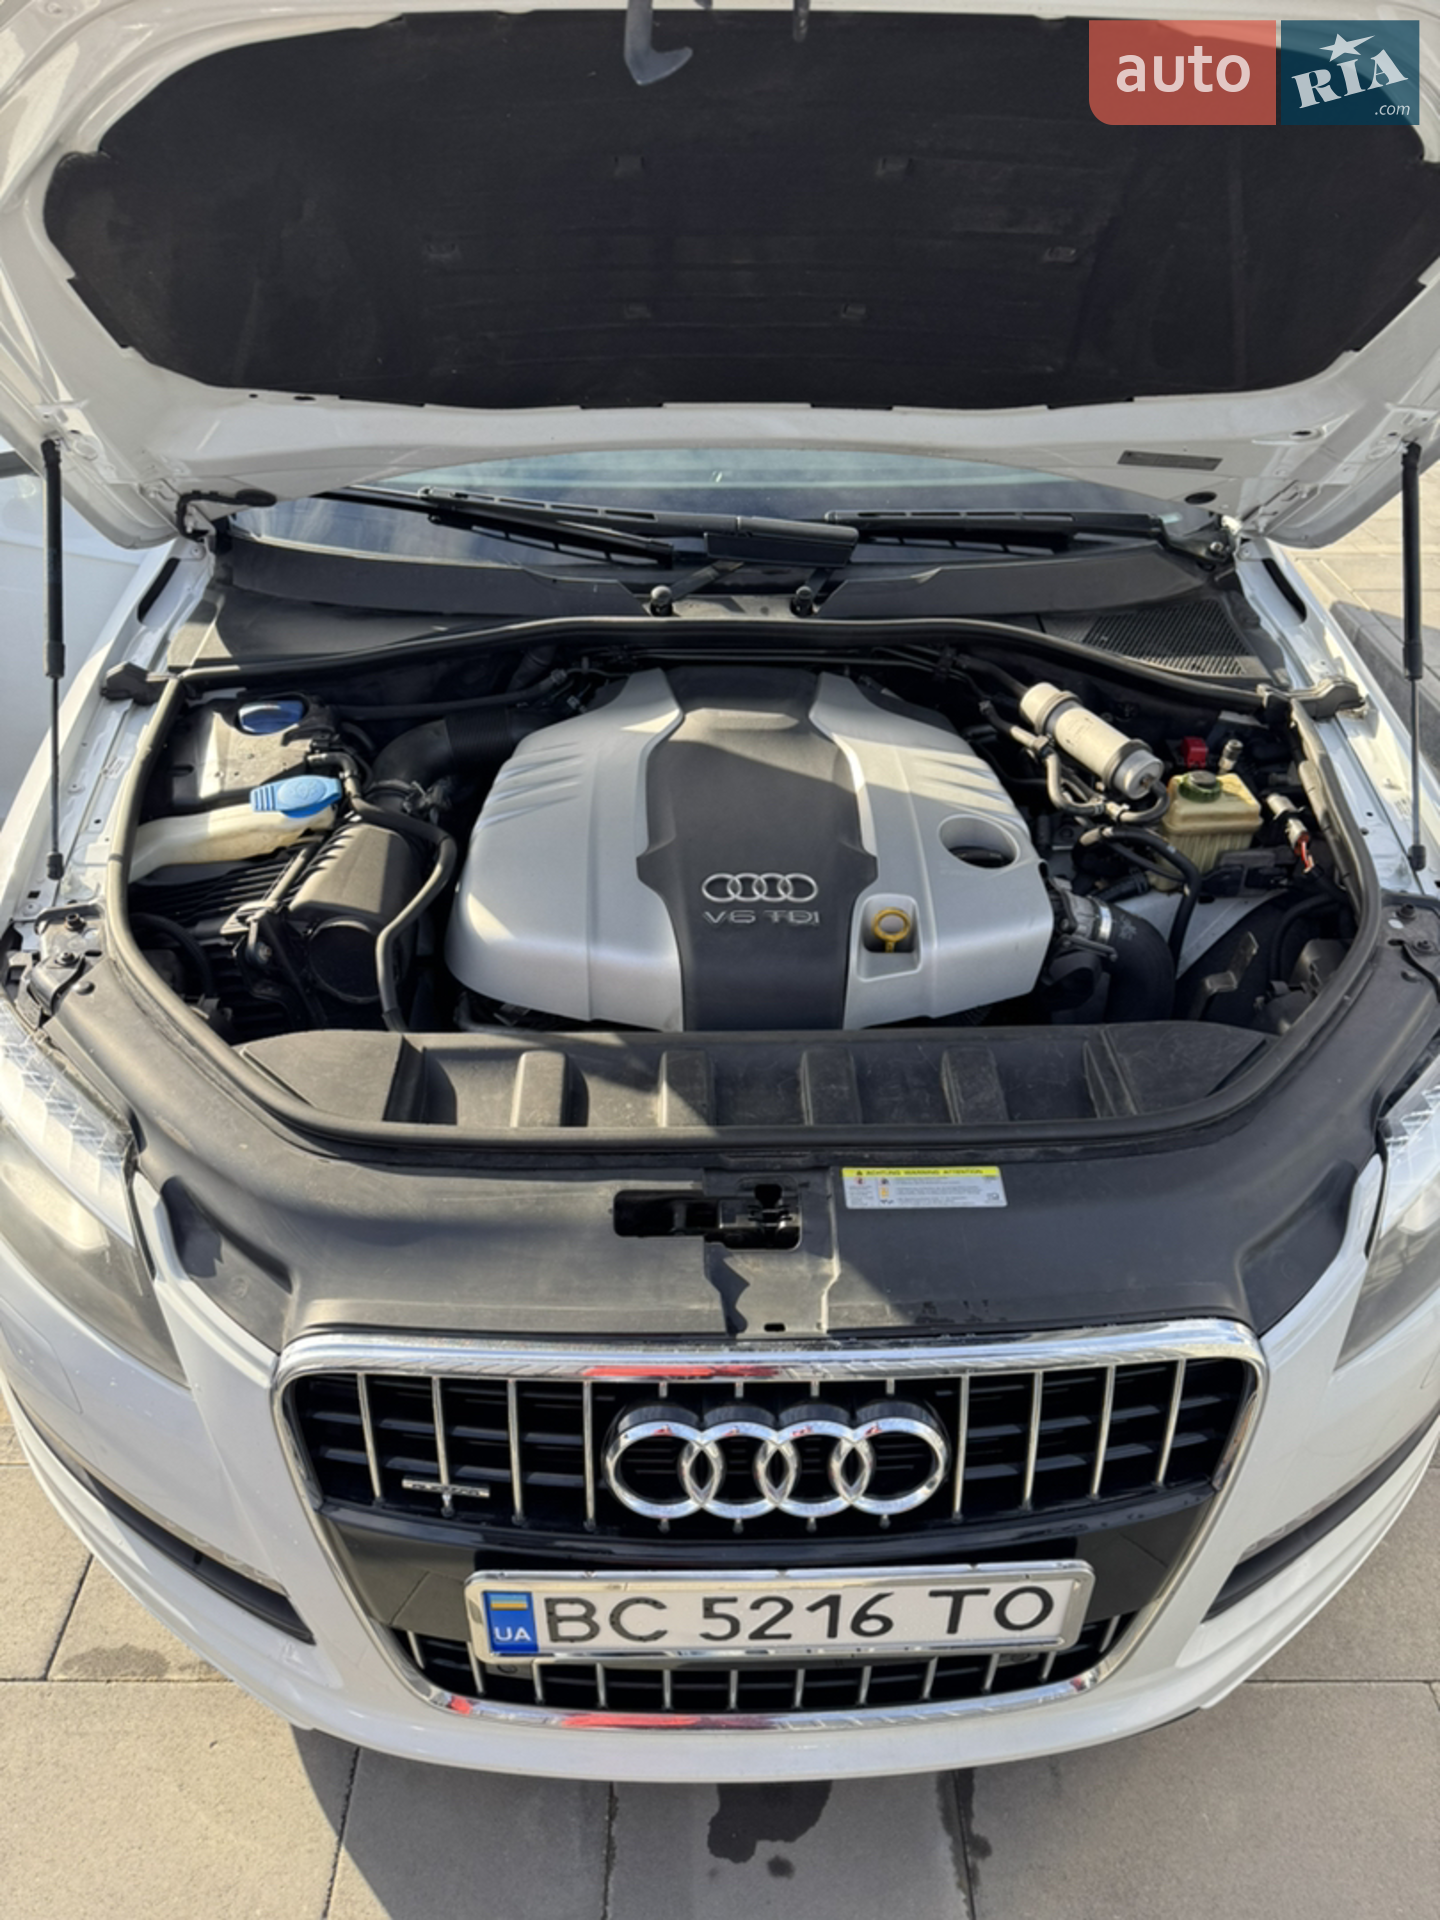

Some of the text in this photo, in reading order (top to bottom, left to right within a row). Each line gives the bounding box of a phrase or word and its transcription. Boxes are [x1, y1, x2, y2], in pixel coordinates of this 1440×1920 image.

[703, 910, 821, 924] V6 TDI
[544, 1585, 1055, 1644] BC 5216 TO
[494, 1626, 531, 1643] UA
